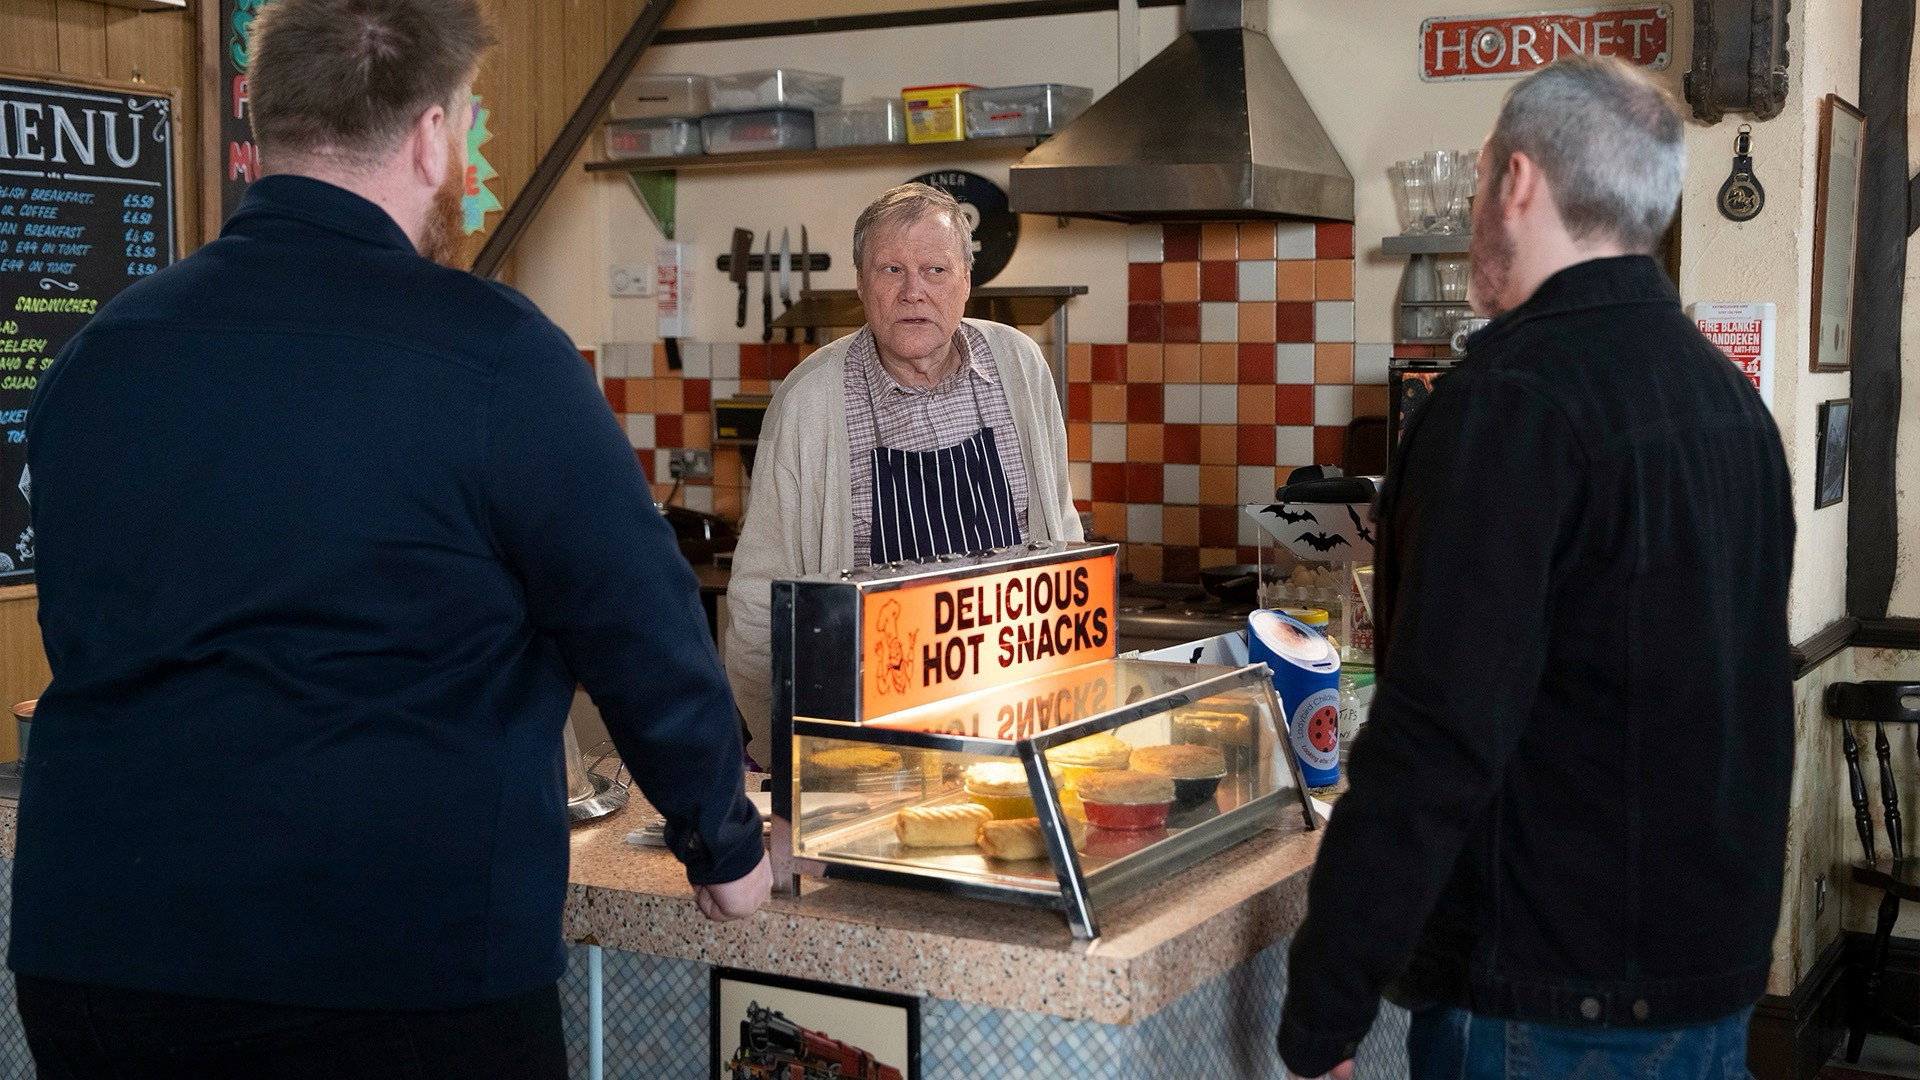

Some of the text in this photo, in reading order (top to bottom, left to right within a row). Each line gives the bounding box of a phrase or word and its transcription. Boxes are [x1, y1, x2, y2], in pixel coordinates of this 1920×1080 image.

[1434, 18, 1656, 71] HORNET
[0, 100, 144, 168] ENU
[1, 204, 15, 216] OR
[19, 204, 59, 219] COFFEE
[24, 223, 85, 239] BREAKFAST
[41, 242, 55, 254] ON
[58, 243, 92, 256] TOAST
[28, 260, 44, 272] ON
[47, 262, 77, 275] TOAST
[15, 296, 98, 315] SANDWICHES
[1700, 321, 1760, 333] FIRE BLANKET
[1703, 333, 1760, 345] RANDDEKEN
[1, 375, 37, 390] SALAD
[934, 566, 1089, 635] DELICIOUS
[922, 607, 1108, 687] HOT SNACKS
[1297, 703, 1313, 739] Ladybird
